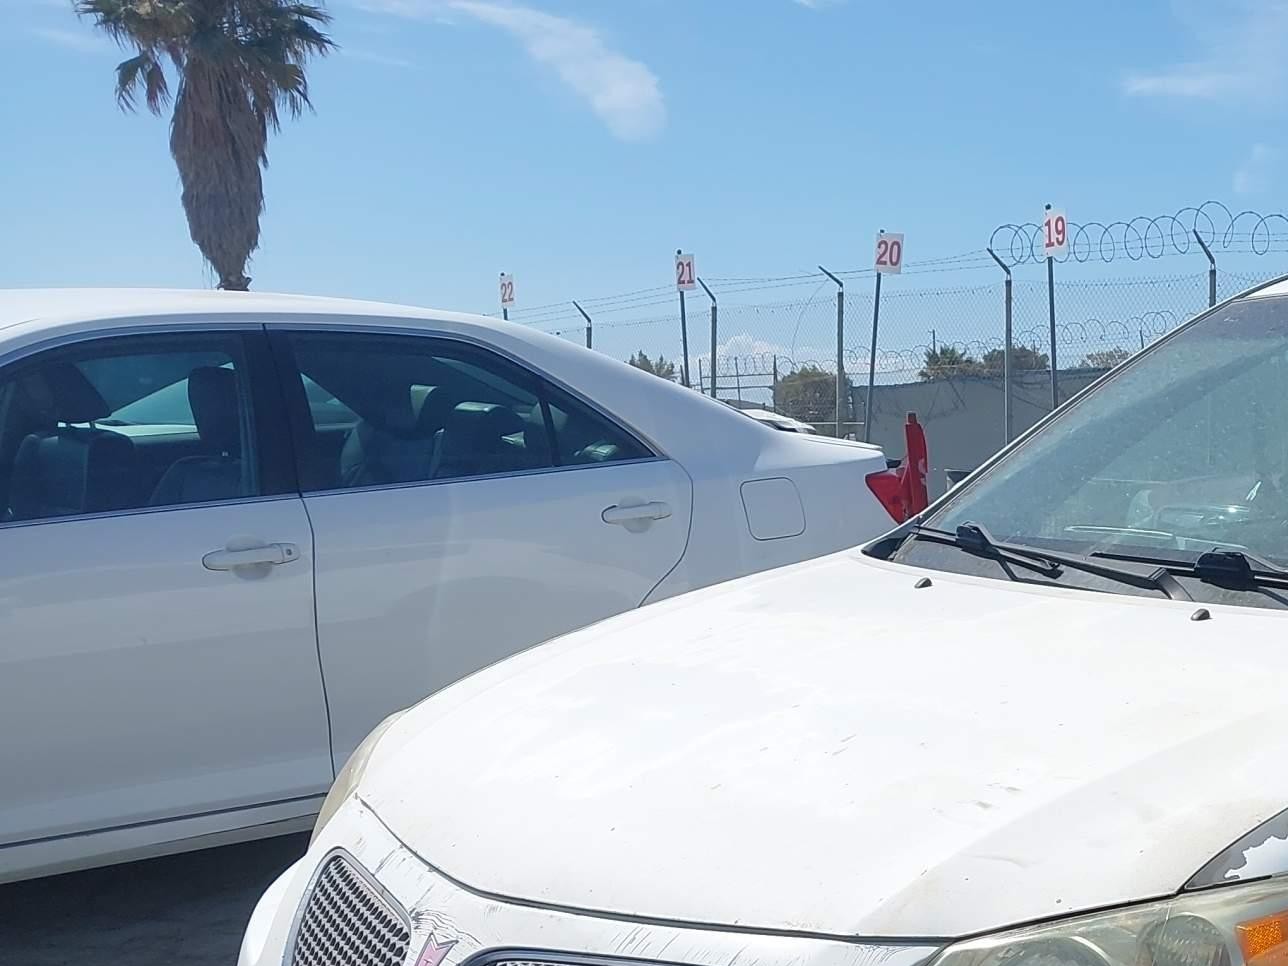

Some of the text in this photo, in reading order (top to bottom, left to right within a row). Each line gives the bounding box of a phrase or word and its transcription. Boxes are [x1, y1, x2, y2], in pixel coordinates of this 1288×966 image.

[1044, 215, 1066, 249] 19
[875, 240, 902, 266] 20
[676, 261, 695, 285] 21
[500, 281, 515, 303] 22
